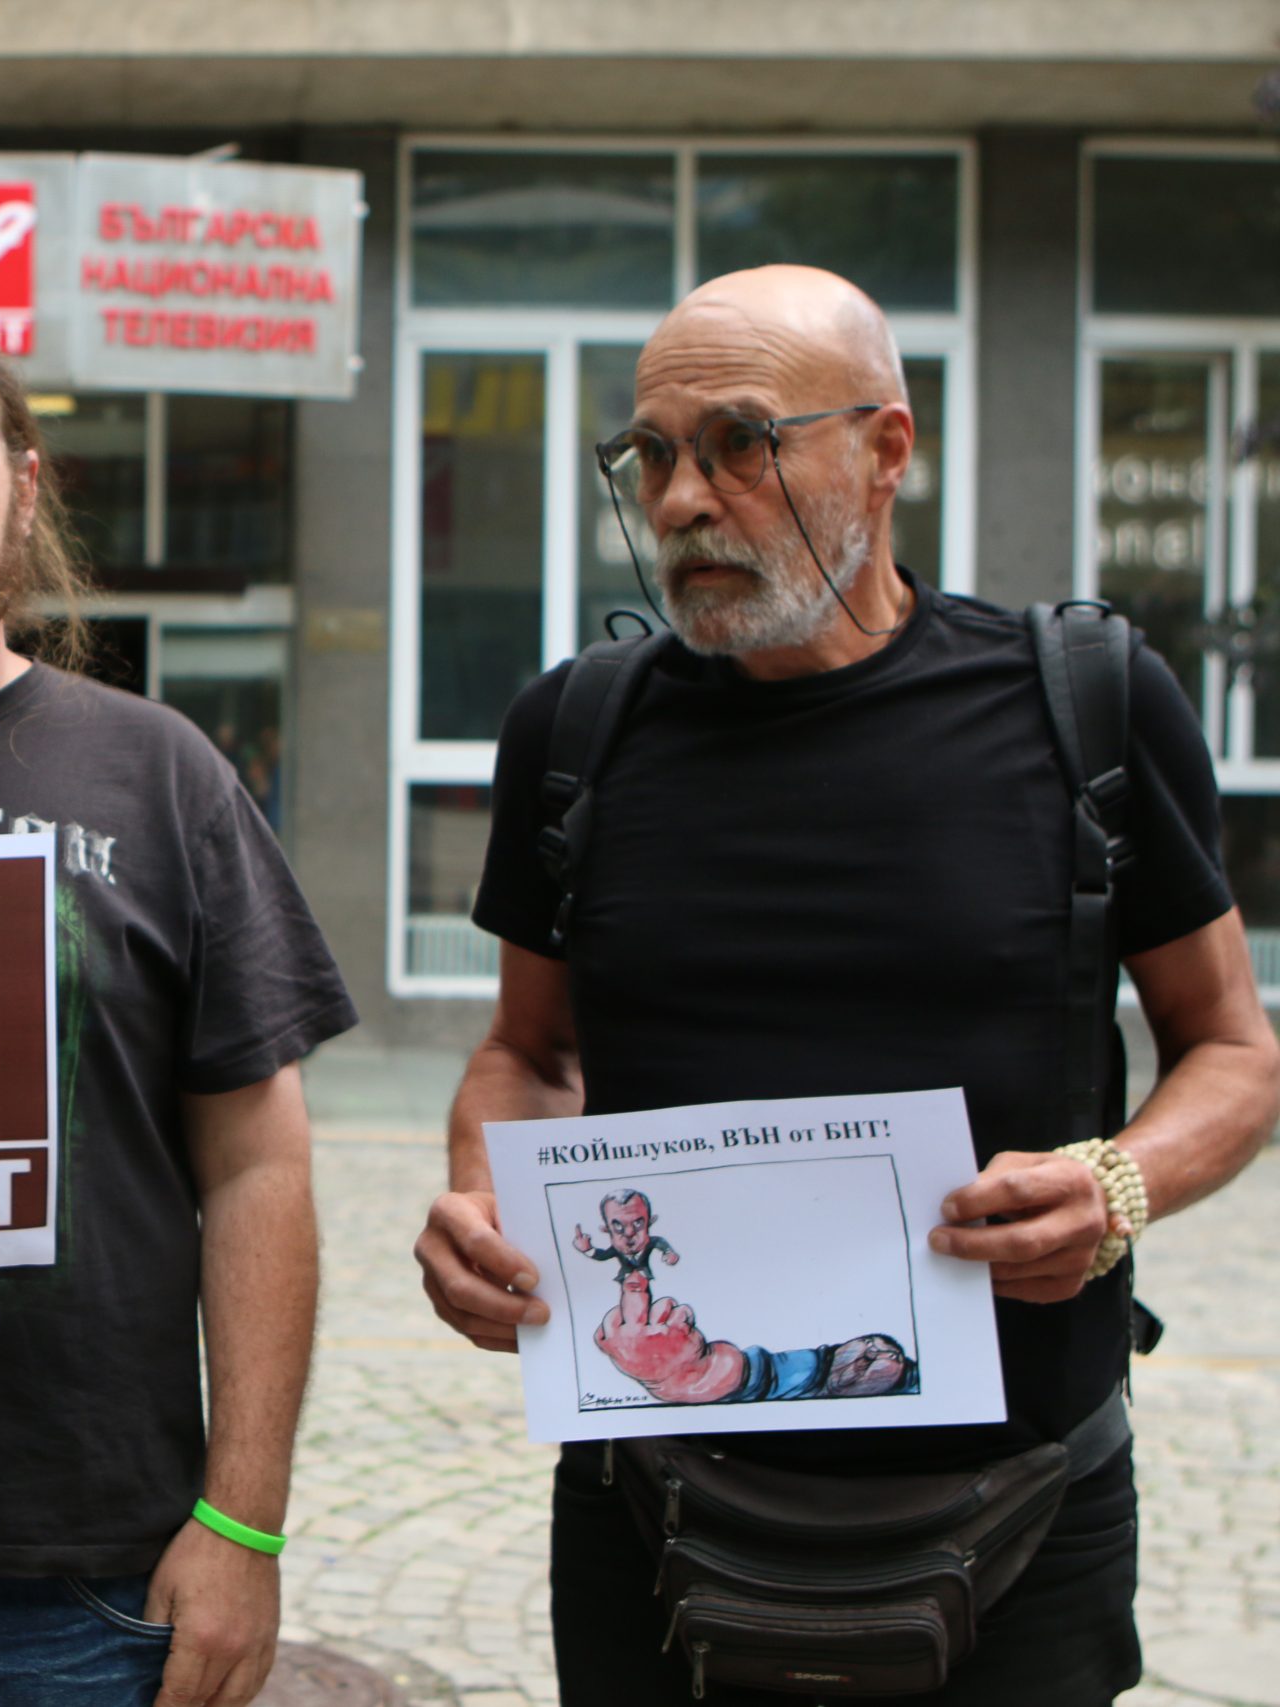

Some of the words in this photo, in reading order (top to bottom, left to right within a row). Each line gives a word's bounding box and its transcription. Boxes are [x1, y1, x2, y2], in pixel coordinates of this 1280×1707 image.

[100, 202, 322, 251] БЪЛГАРСКА
[81, 256, 335, 303] НАЦИОНАЛНА
[102, 308, 317, 353] ТЕЛЕВИЗИЯ
[538, 1137, 715, 1165] #КОЙшлуков,
[721, 1126, 780, 1148] ВЪН
[789, 1128, 815, 1143] от
[824, 1119, 891, 1141] БНТ!
